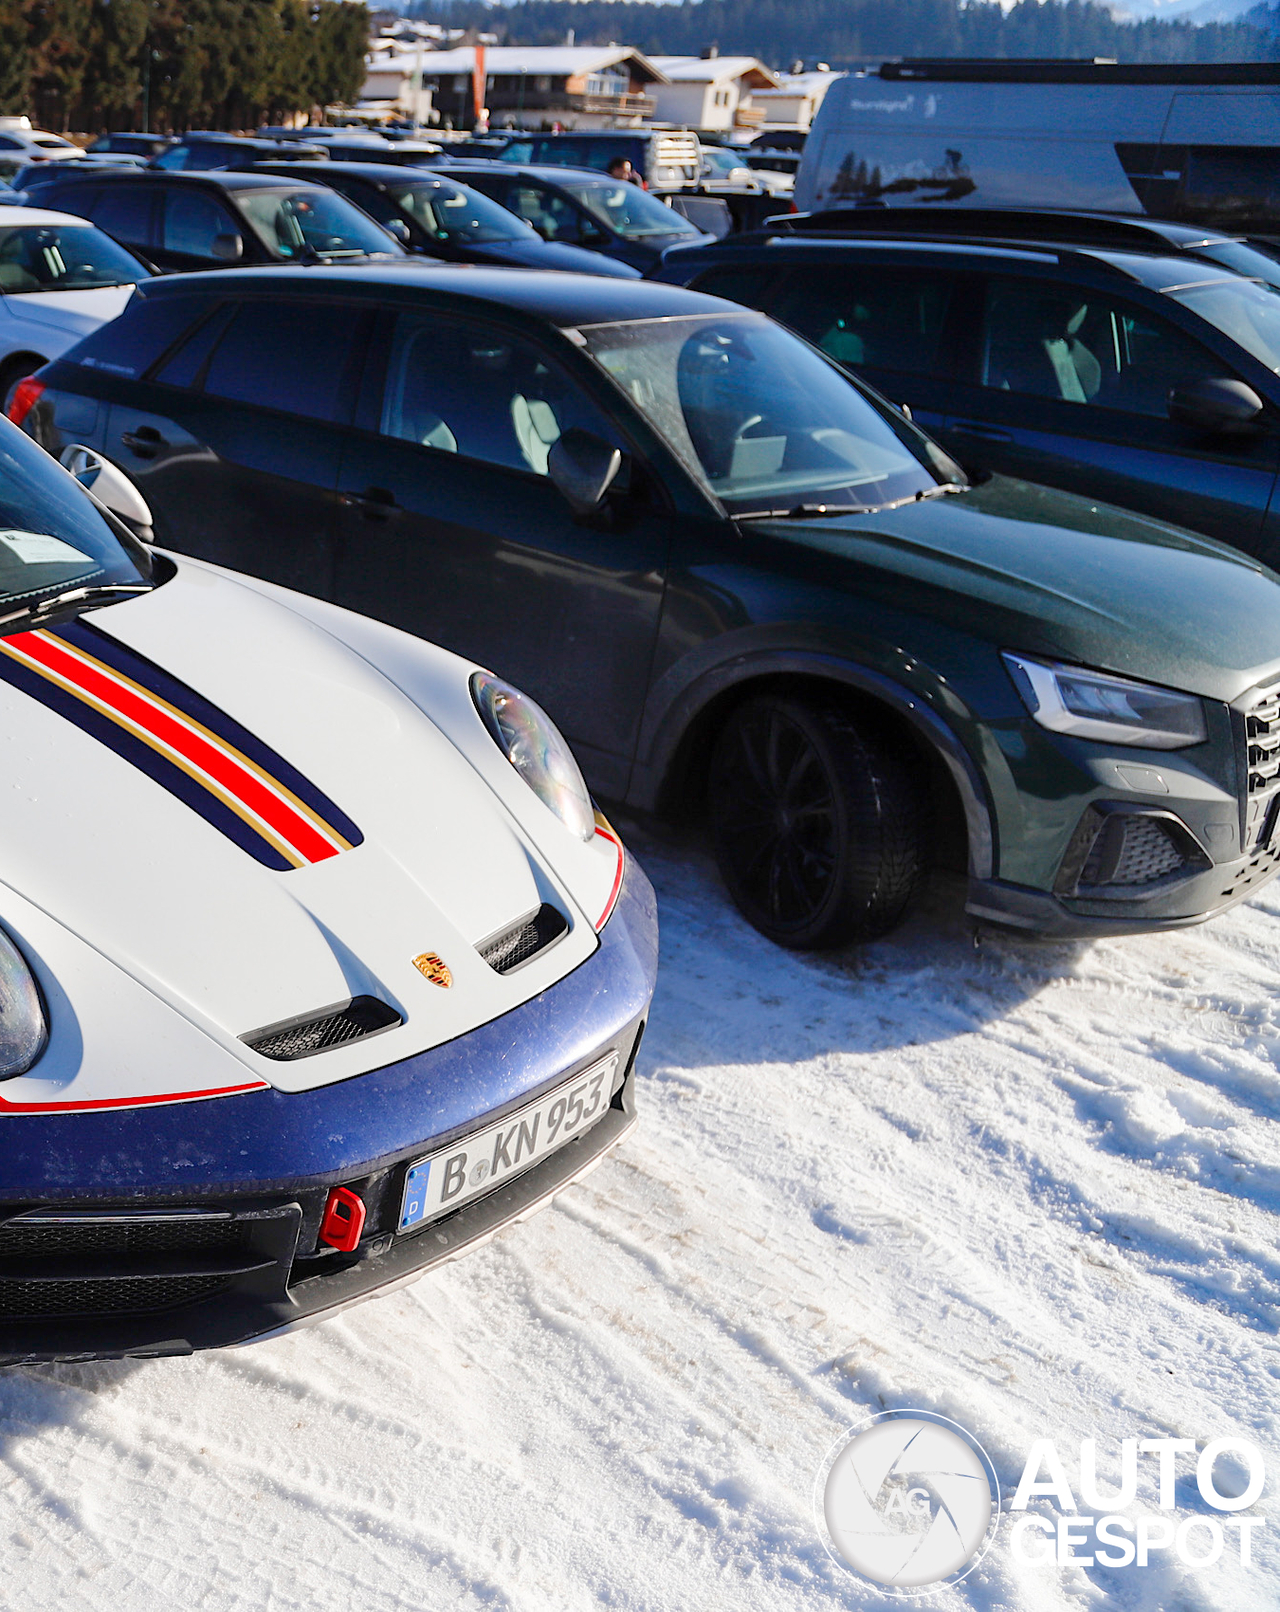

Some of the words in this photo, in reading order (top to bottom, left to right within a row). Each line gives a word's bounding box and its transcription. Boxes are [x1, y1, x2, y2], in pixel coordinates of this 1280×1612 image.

[442, 1151, 468, 1203] B
[490, 1110, 542, 1177] KN
[547, 1072, 605, 1145] 953
[408, 1201, 418, 1216] D
